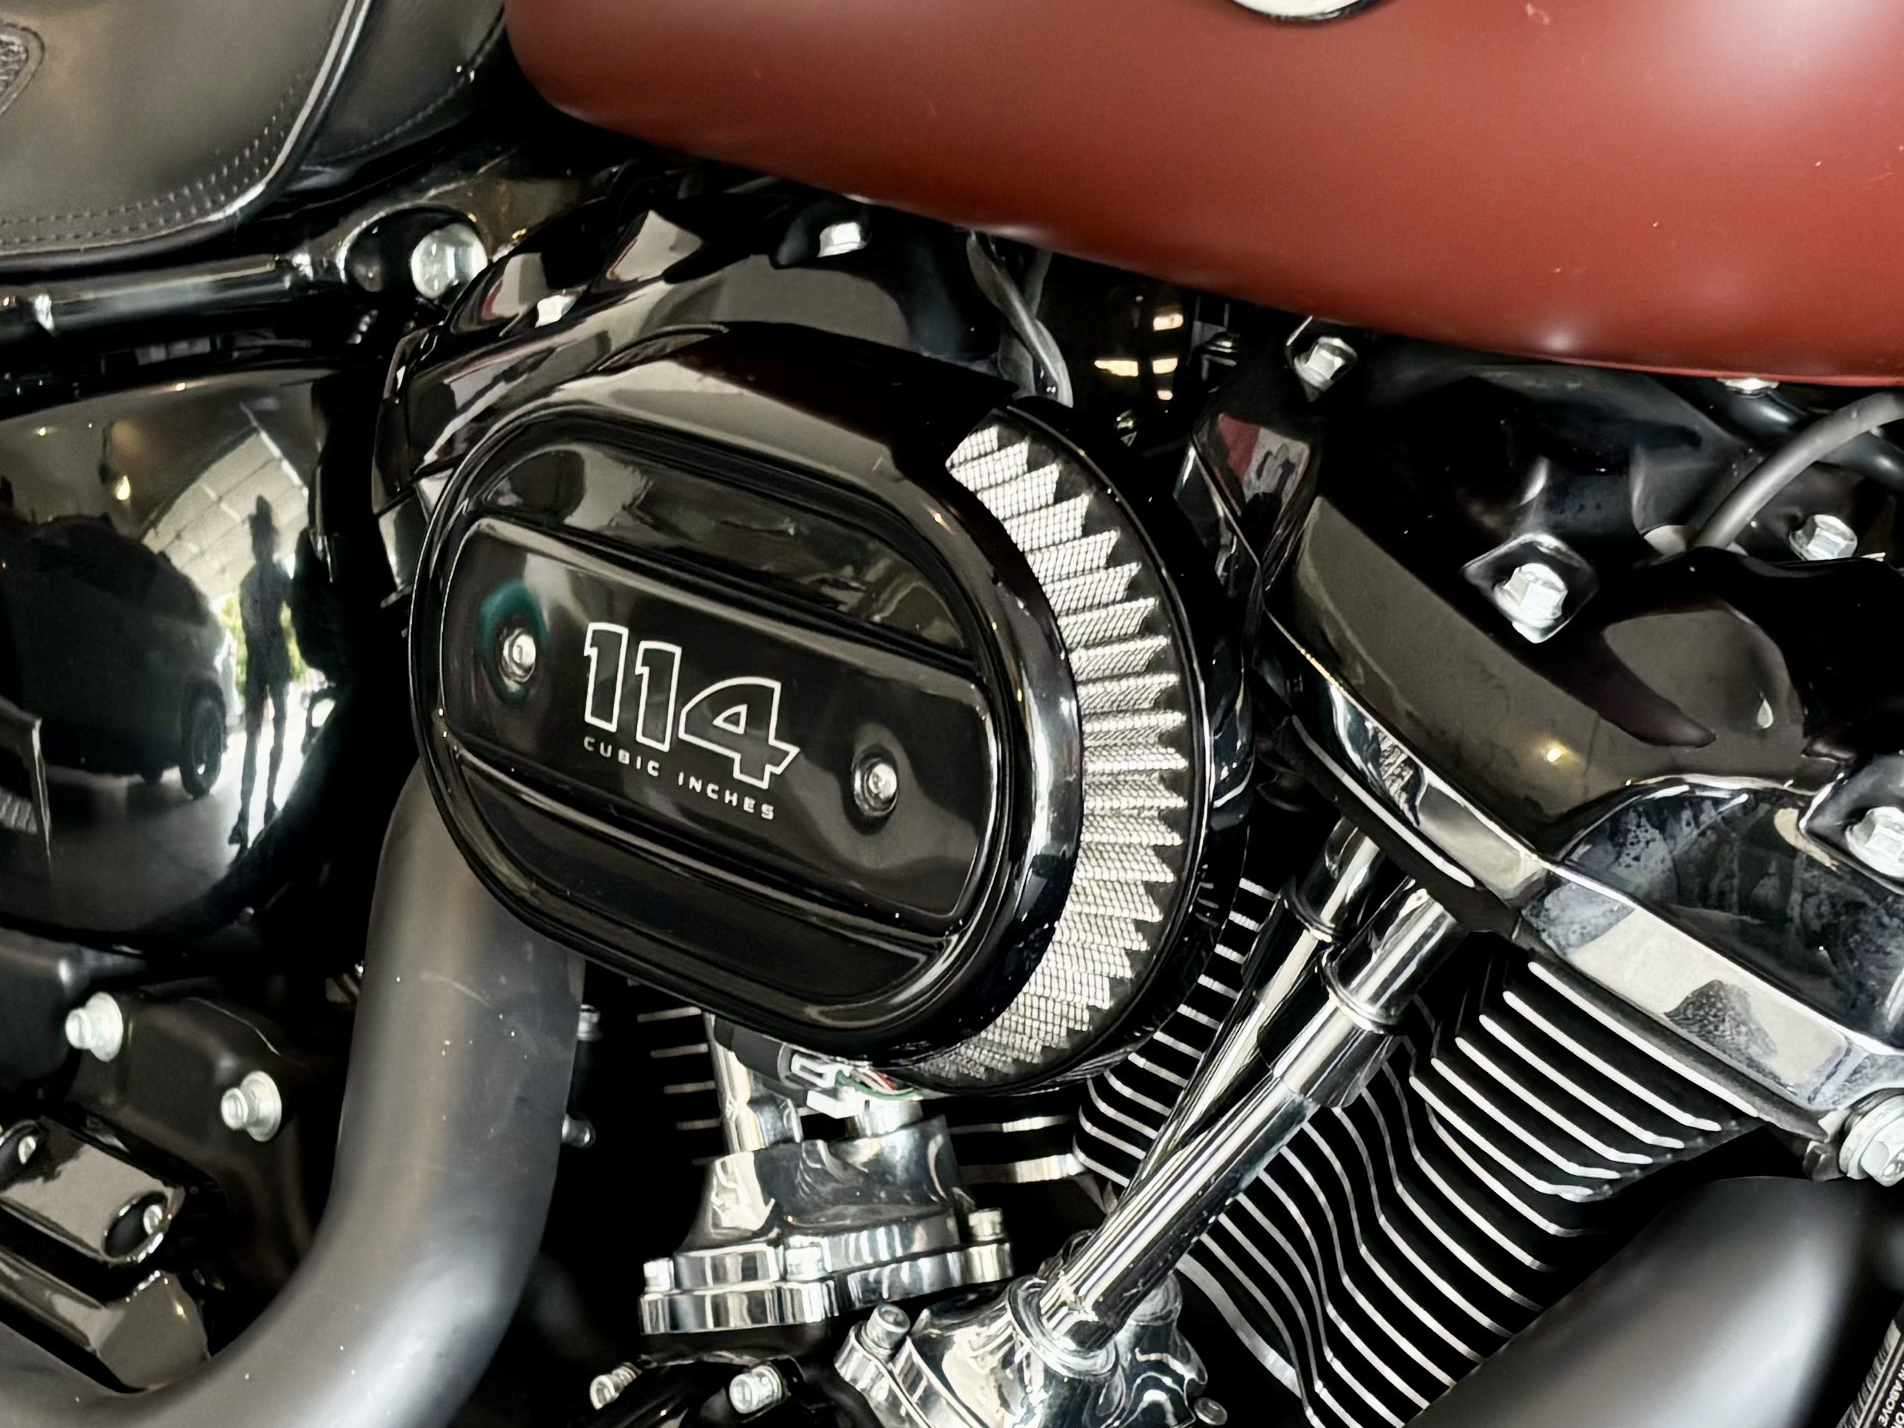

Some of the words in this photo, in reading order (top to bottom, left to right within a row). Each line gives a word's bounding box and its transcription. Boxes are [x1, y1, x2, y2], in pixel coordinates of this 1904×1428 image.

[583, 622, 801, 790] 114
[583, 736, 661, 779] CUBIC
[677, 772, 776, 821] INCHES
[1878, 1379, 1903, 1427] ABOVE
